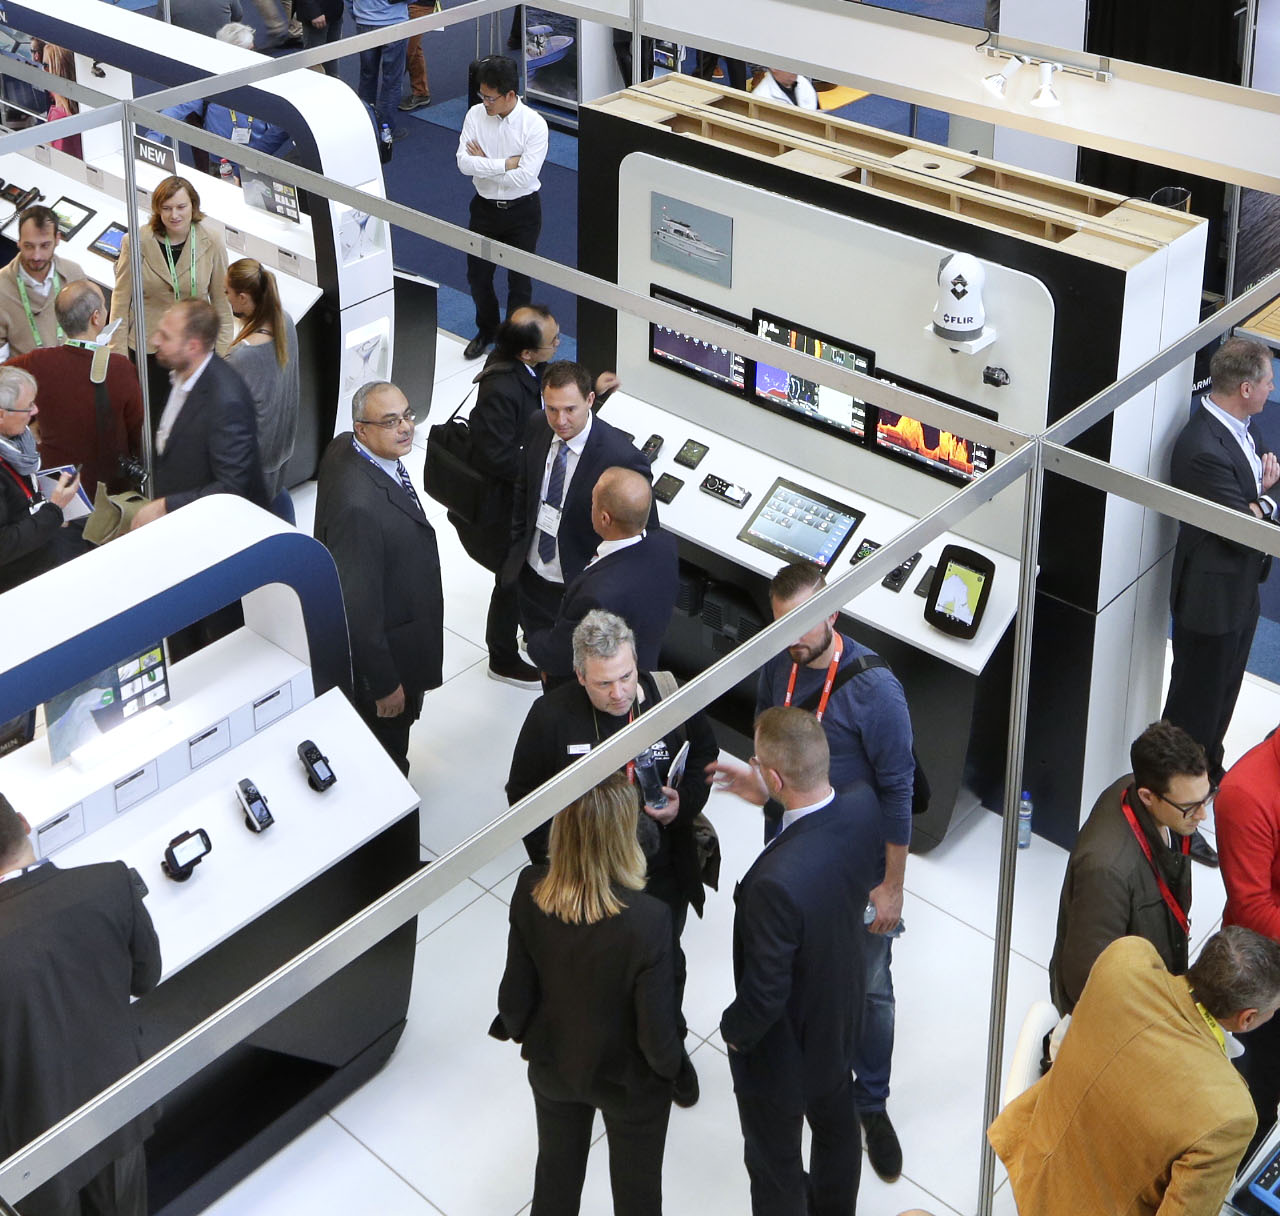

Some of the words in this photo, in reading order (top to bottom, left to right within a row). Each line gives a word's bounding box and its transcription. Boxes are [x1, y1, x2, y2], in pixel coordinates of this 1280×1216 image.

[139, 142, 168, 166] NEW
[950, 315, 974, 324] FLIR
[1191, 376, 1212, 391] ARMI
